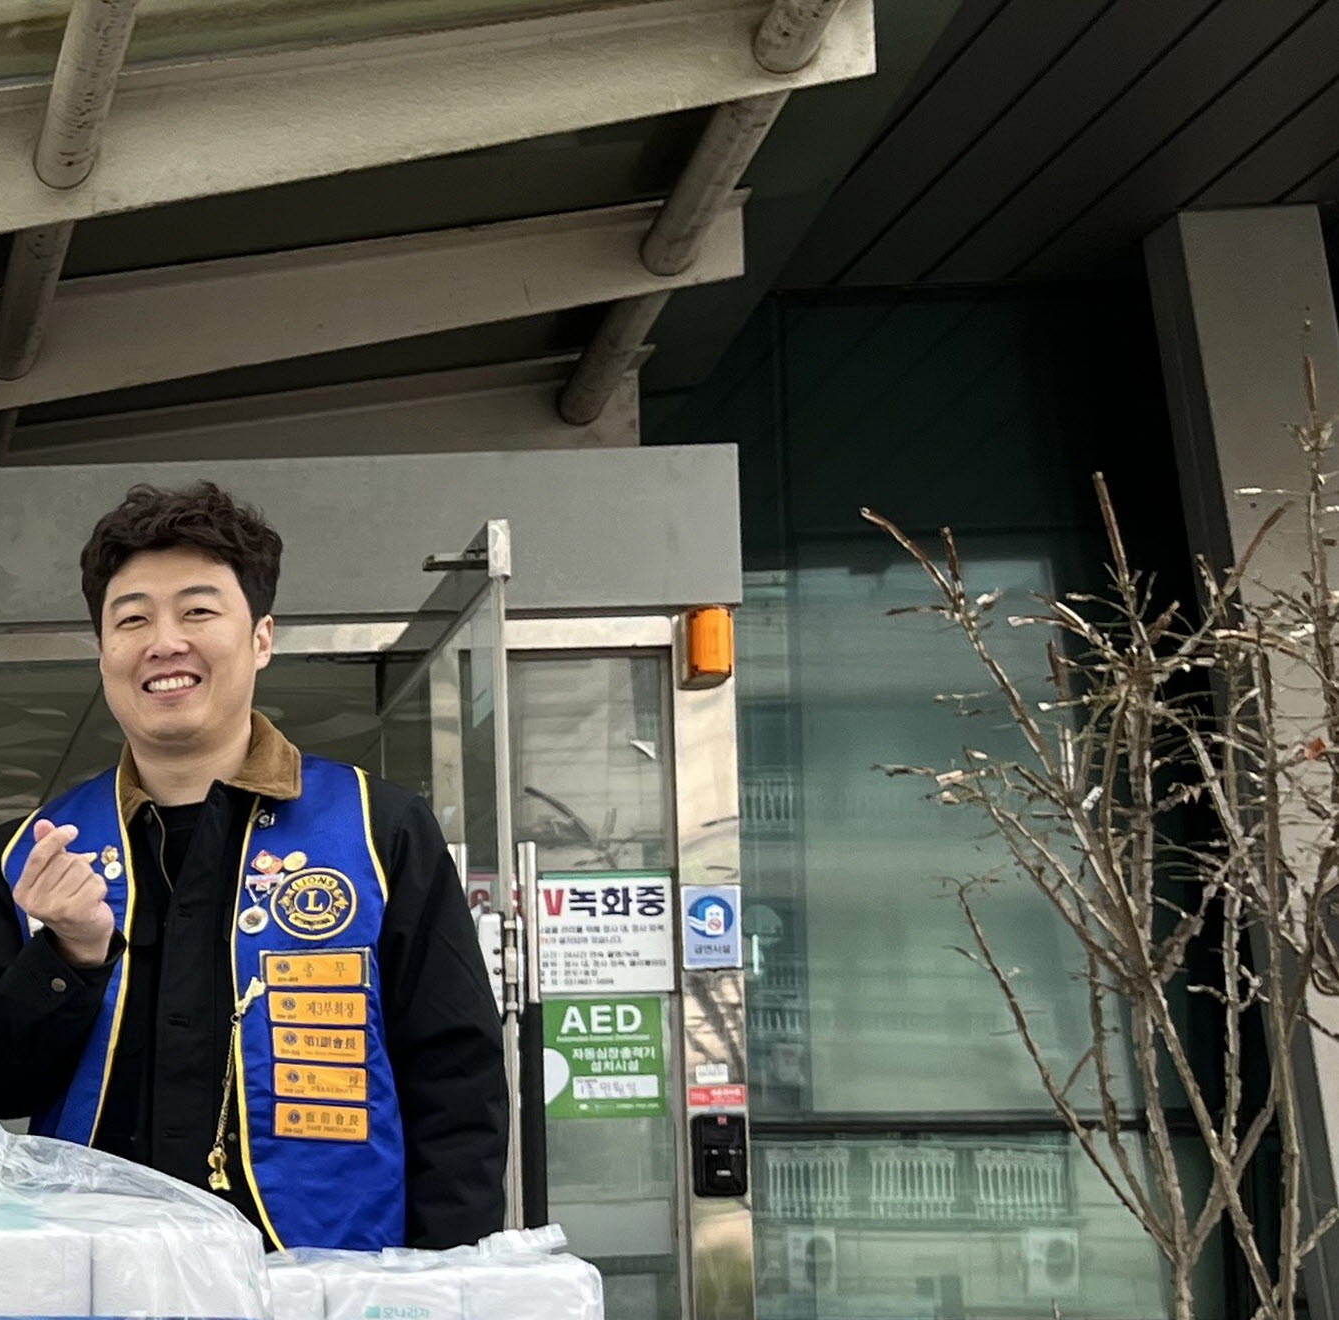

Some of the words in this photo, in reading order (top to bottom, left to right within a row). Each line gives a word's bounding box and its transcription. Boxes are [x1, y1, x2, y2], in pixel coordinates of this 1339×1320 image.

[294, 876, 336, 889] LIONS
[304, 889, 324, 912] L
[560, 1004, 643, 1034] AED
